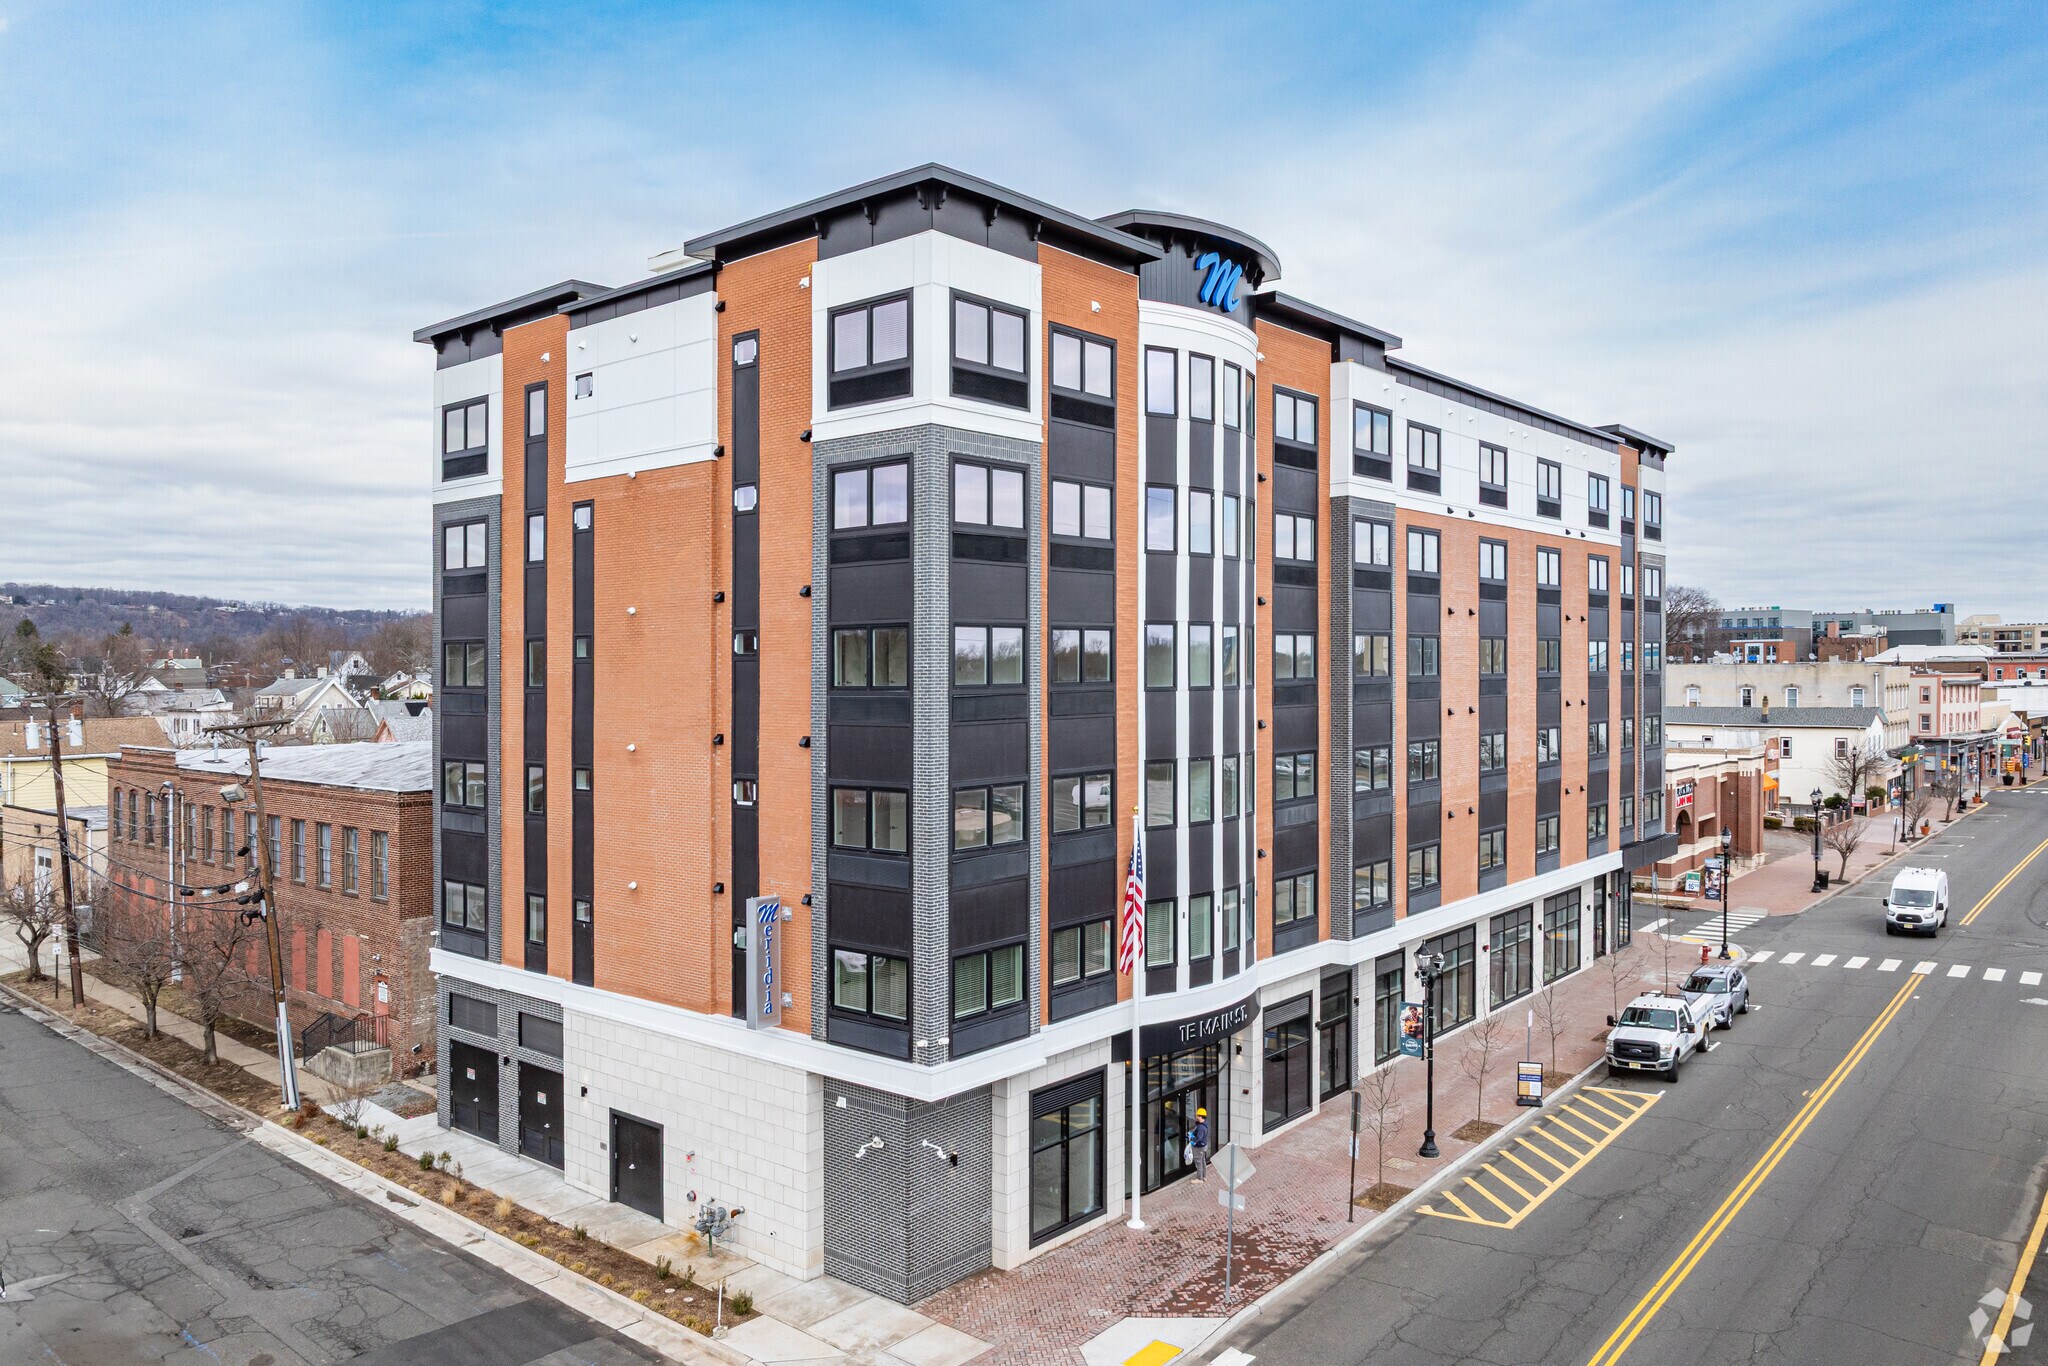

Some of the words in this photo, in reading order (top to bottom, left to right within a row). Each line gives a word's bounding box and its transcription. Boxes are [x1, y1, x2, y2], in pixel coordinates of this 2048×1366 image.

[1195, 251, 1242, 313] M
[757, 902, 780, 1014] Meridia
[1199, 1011, 1233, 1037] MAIN
